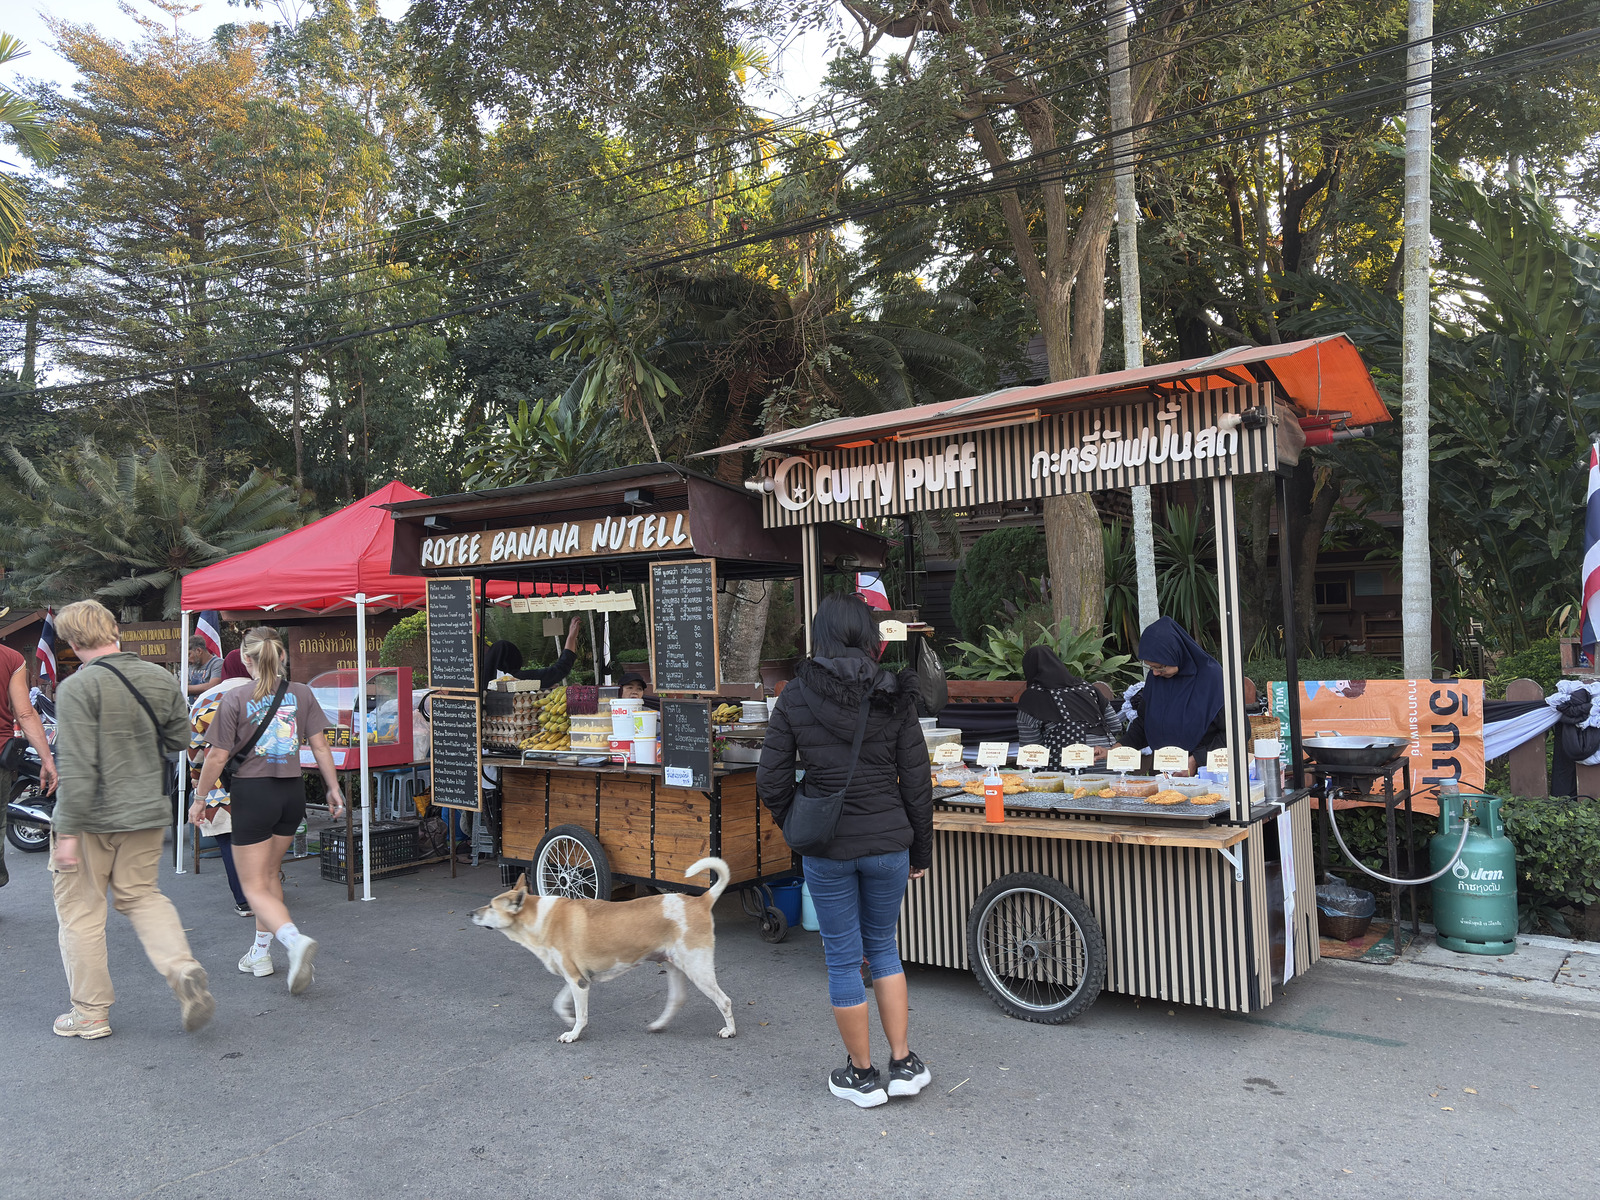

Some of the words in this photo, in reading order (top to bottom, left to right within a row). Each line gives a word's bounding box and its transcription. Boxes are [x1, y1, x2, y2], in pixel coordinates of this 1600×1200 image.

[421, 534, 481, 567] ROTEE
[490, 522, 580, 562] BANANA
[592, 514, 694, 551] NUTELL
